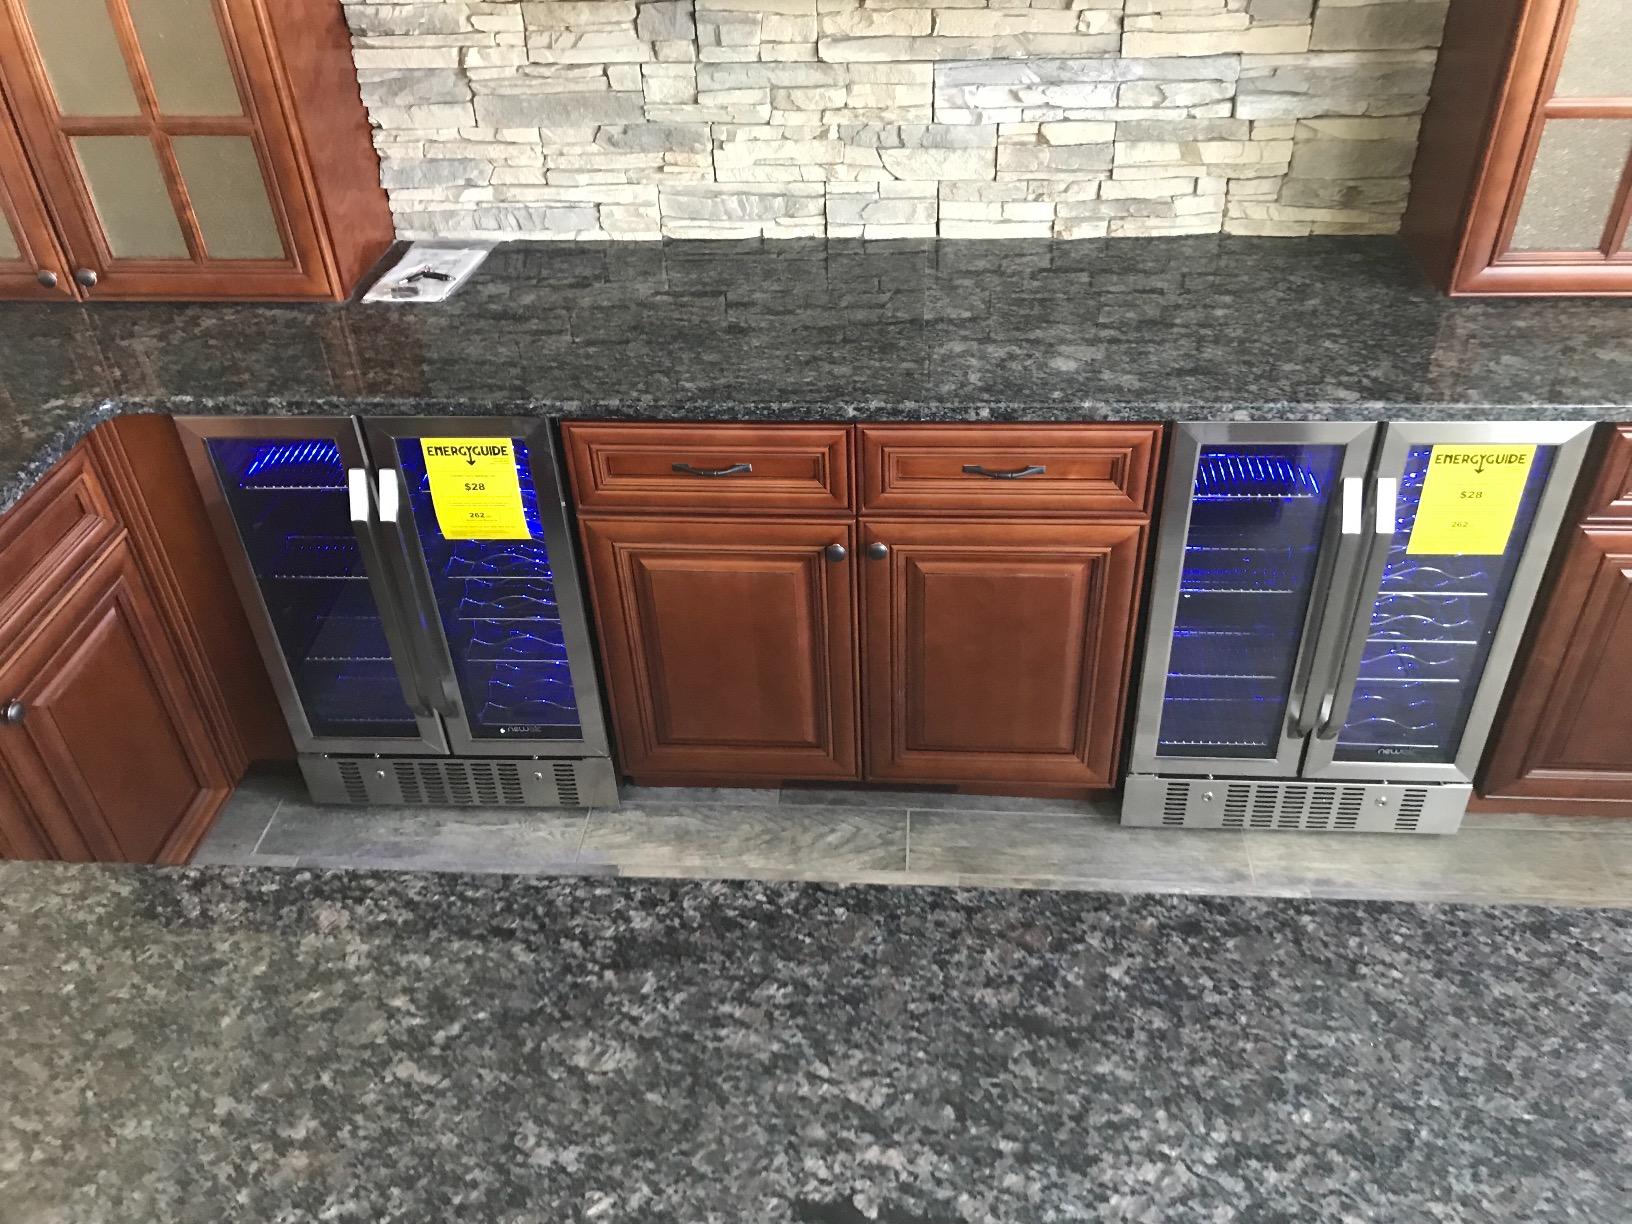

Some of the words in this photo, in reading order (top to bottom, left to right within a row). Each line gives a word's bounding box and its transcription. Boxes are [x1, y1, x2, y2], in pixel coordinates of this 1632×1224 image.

[427, 445, 509, 456] ENERGYGUIDE
[1434, 453, 1527, 464] ENERGYGUIDE
[464, 482, 486, 491] $28
[1459, 490, 1483, 499] $28
